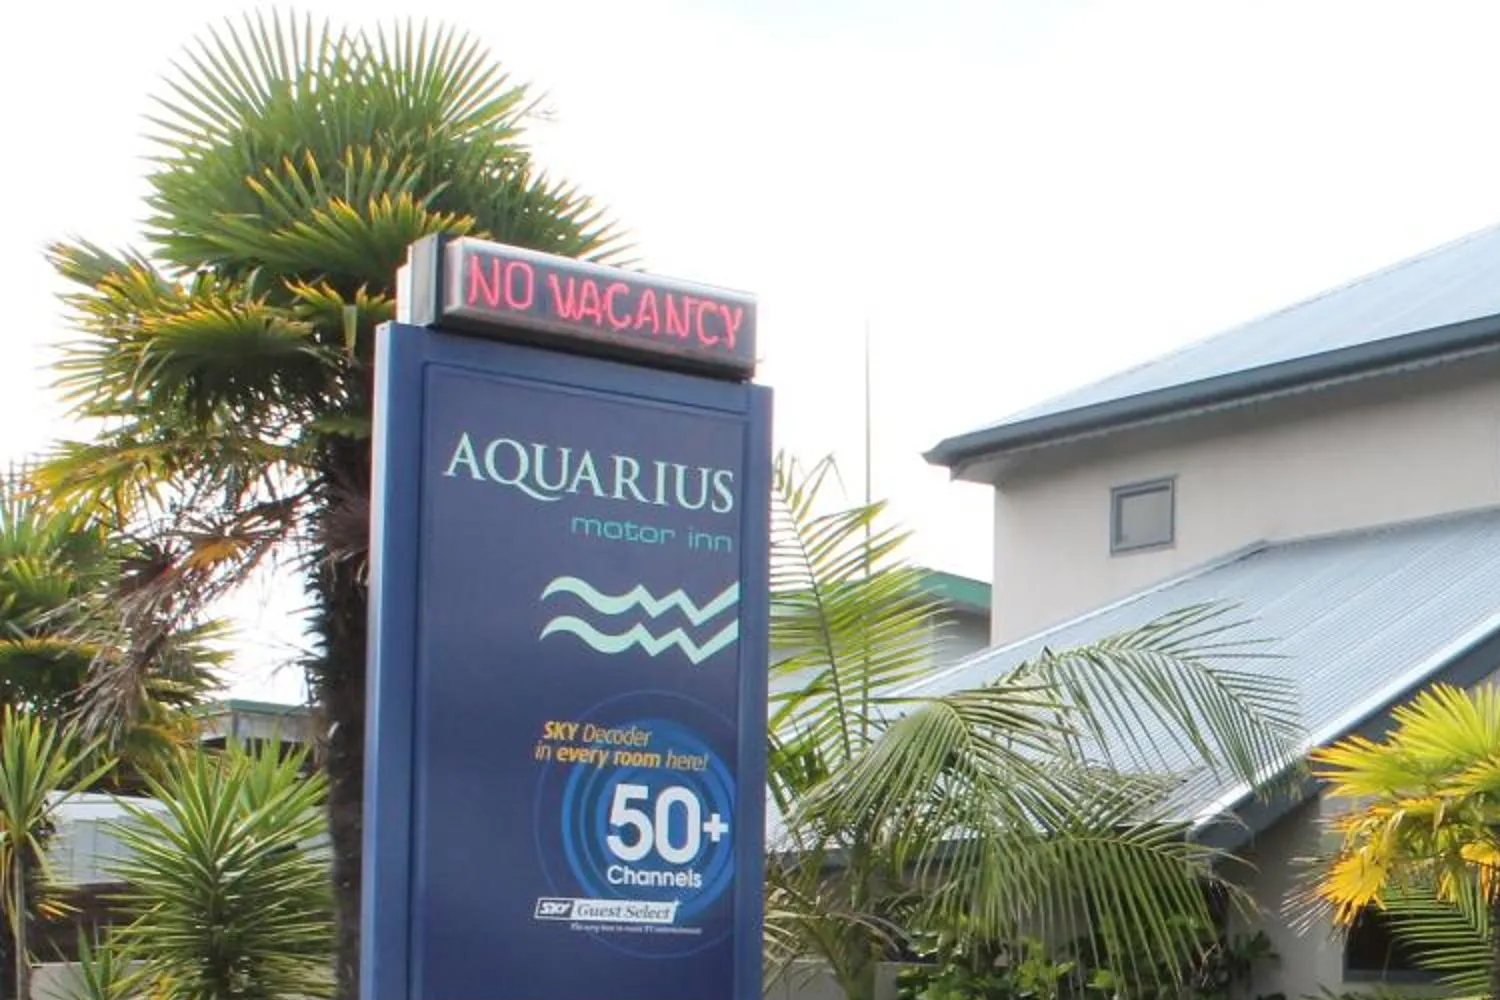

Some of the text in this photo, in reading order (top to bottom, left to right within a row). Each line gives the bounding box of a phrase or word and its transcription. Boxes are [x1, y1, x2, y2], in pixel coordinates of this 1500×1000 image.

[467, 254, 744, 349] NO VACANCY
[443, 431, 735, 513] AQUARIUS
[571, 516, 732, 553] motor inn
[543, 720, 653, 747] SKY Decoder
[535, 740, 709, 772] in every room here!
[606, 783, 729, 865] 50+
[606, 864, 703, 889] Channels
[577, 903, 622, 918] Guest
[623, 901, 671, 919] Select
